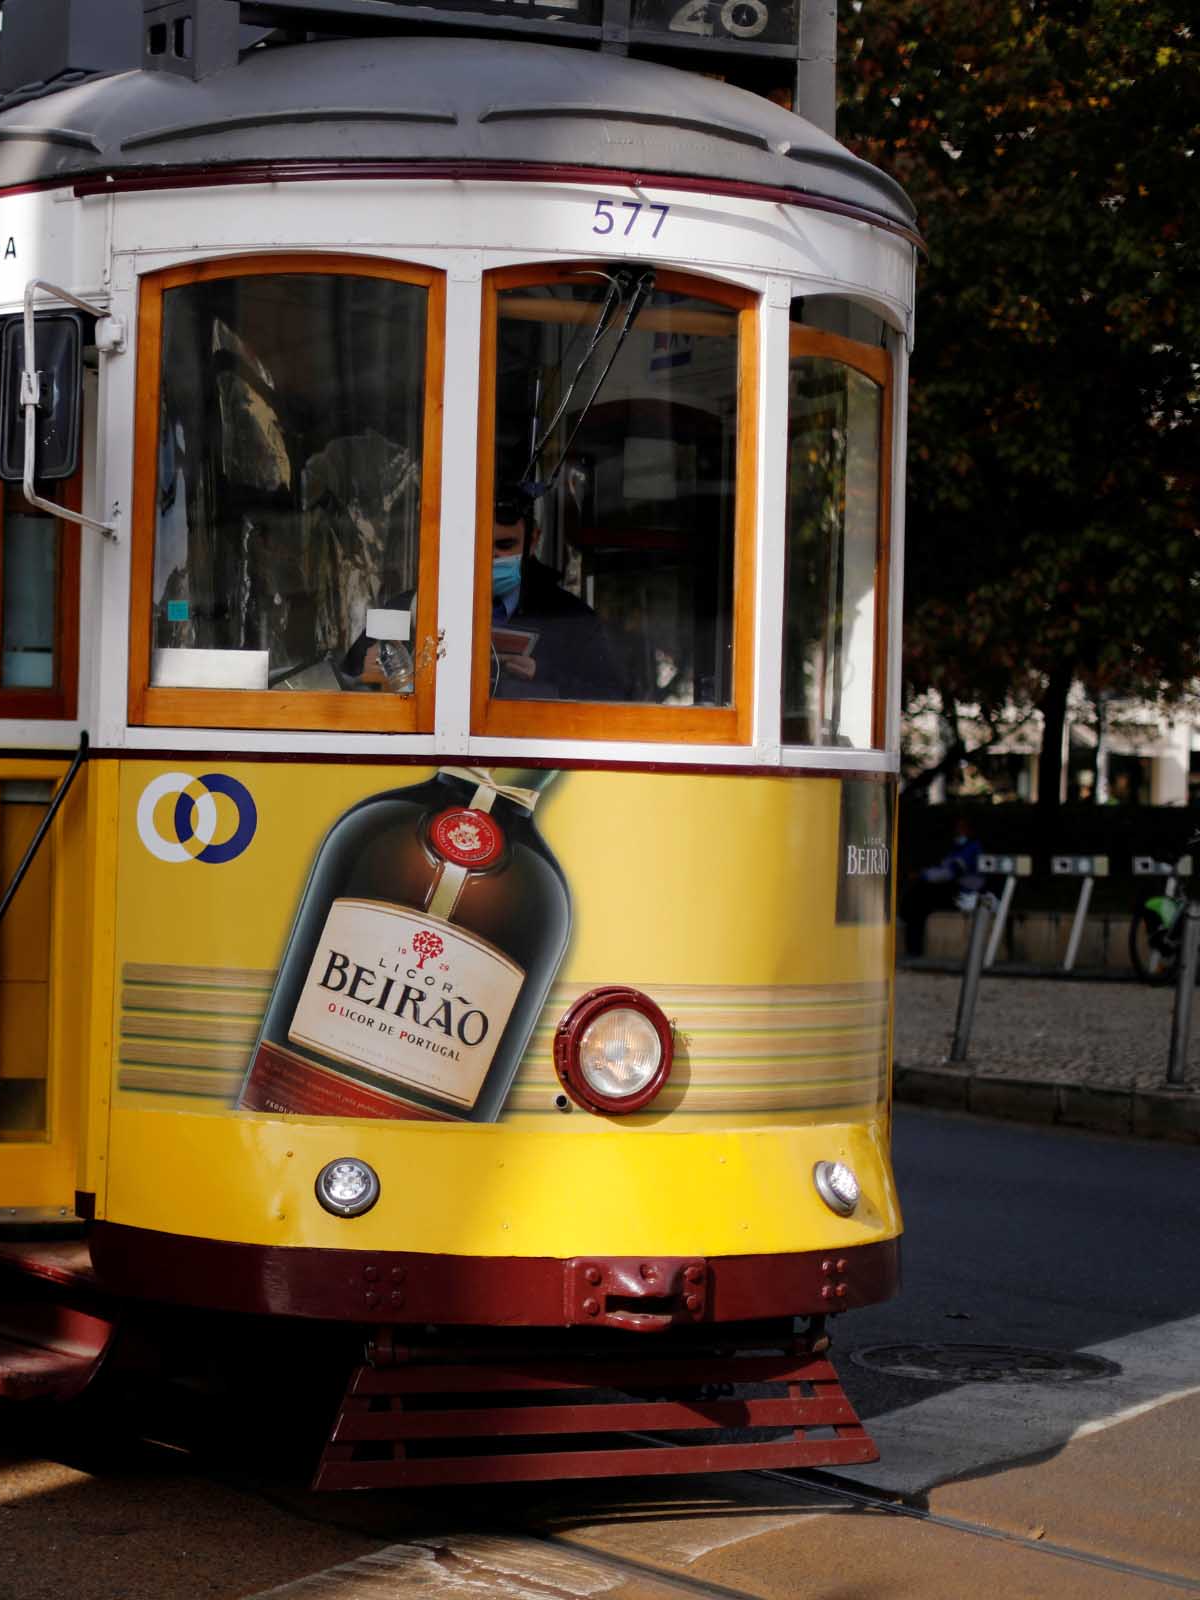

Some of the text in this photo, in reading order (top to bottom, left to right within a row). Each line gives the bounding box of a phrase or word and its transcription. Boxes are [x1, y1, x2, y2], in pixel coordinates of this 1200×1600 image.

[591, 199, 671, 238] 577
[318, 949, 489, 1046] BEIRÃO
[378, 957, 454, 994] LICOR
[328, 1002, 461, 1063] O LICOR DE PORTUGAL
